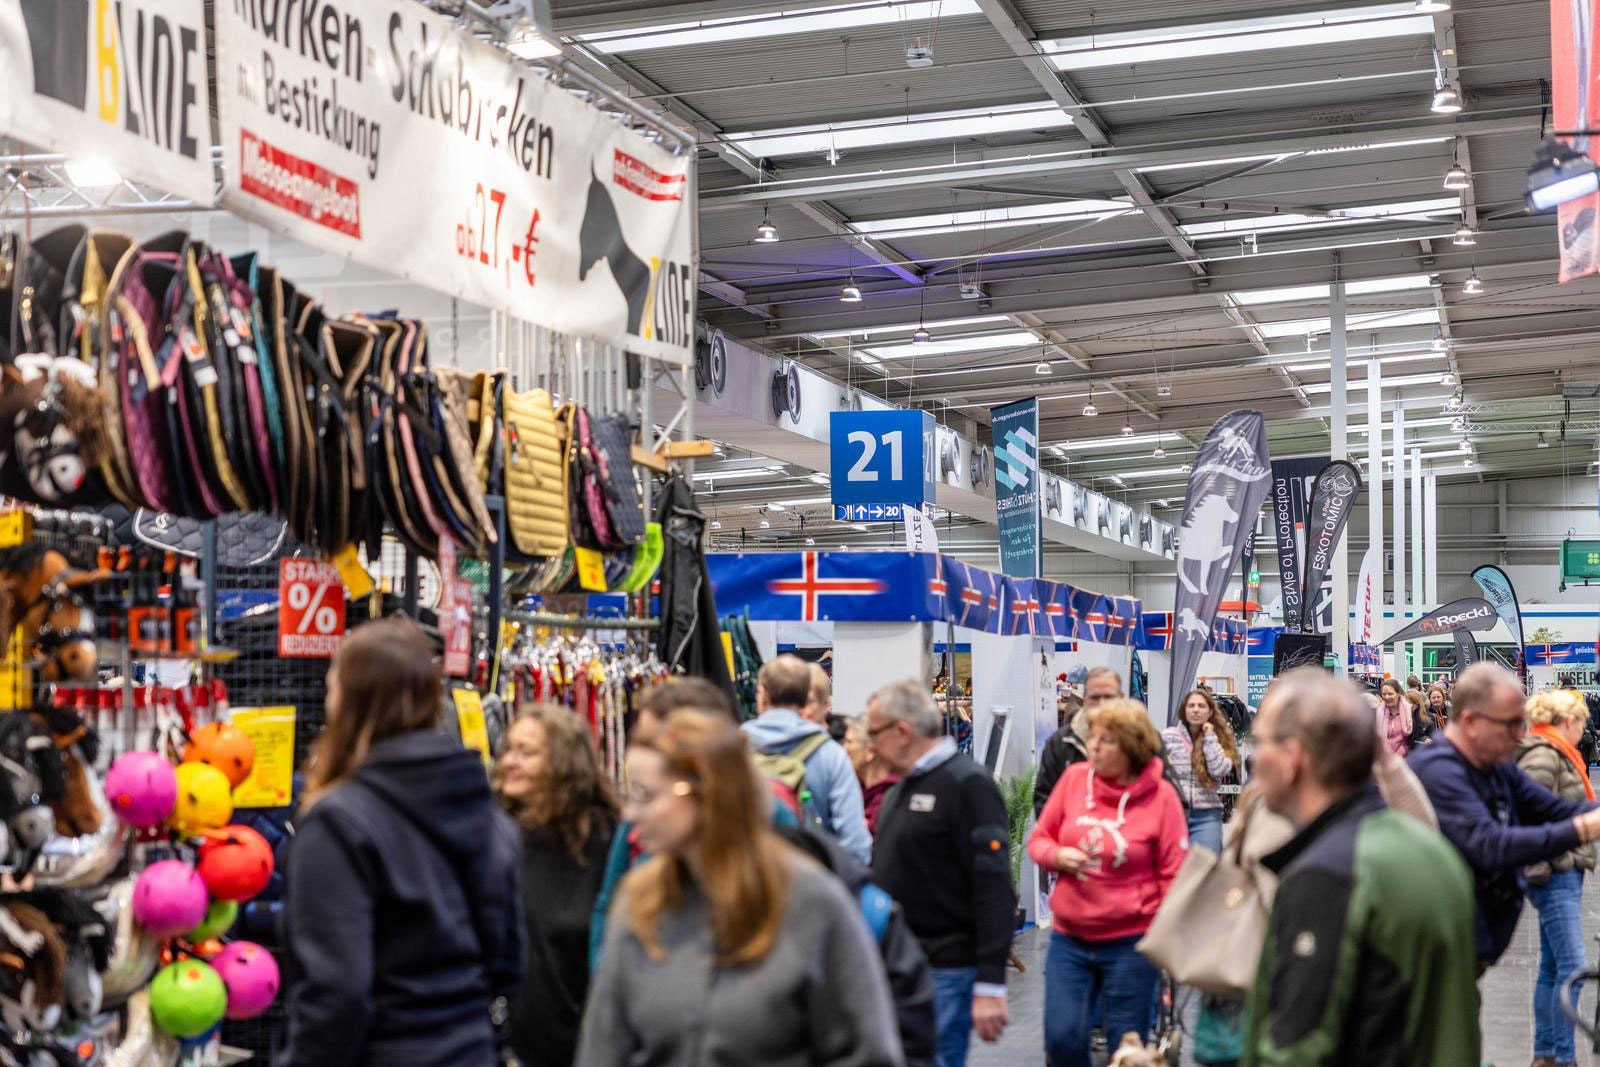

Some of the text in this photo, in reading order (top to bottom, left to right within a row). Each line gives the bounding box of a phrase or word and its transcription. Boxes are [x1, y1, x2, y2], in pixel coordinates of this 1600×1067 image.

[262, 50, 380, 180] Bestickung
[847, 430, 903, 482] 21
[885, 506, 899, 517] 20
[1312, 497, 1343, 571] ESKOTOMIC
[288, 583, 337, 633] %
